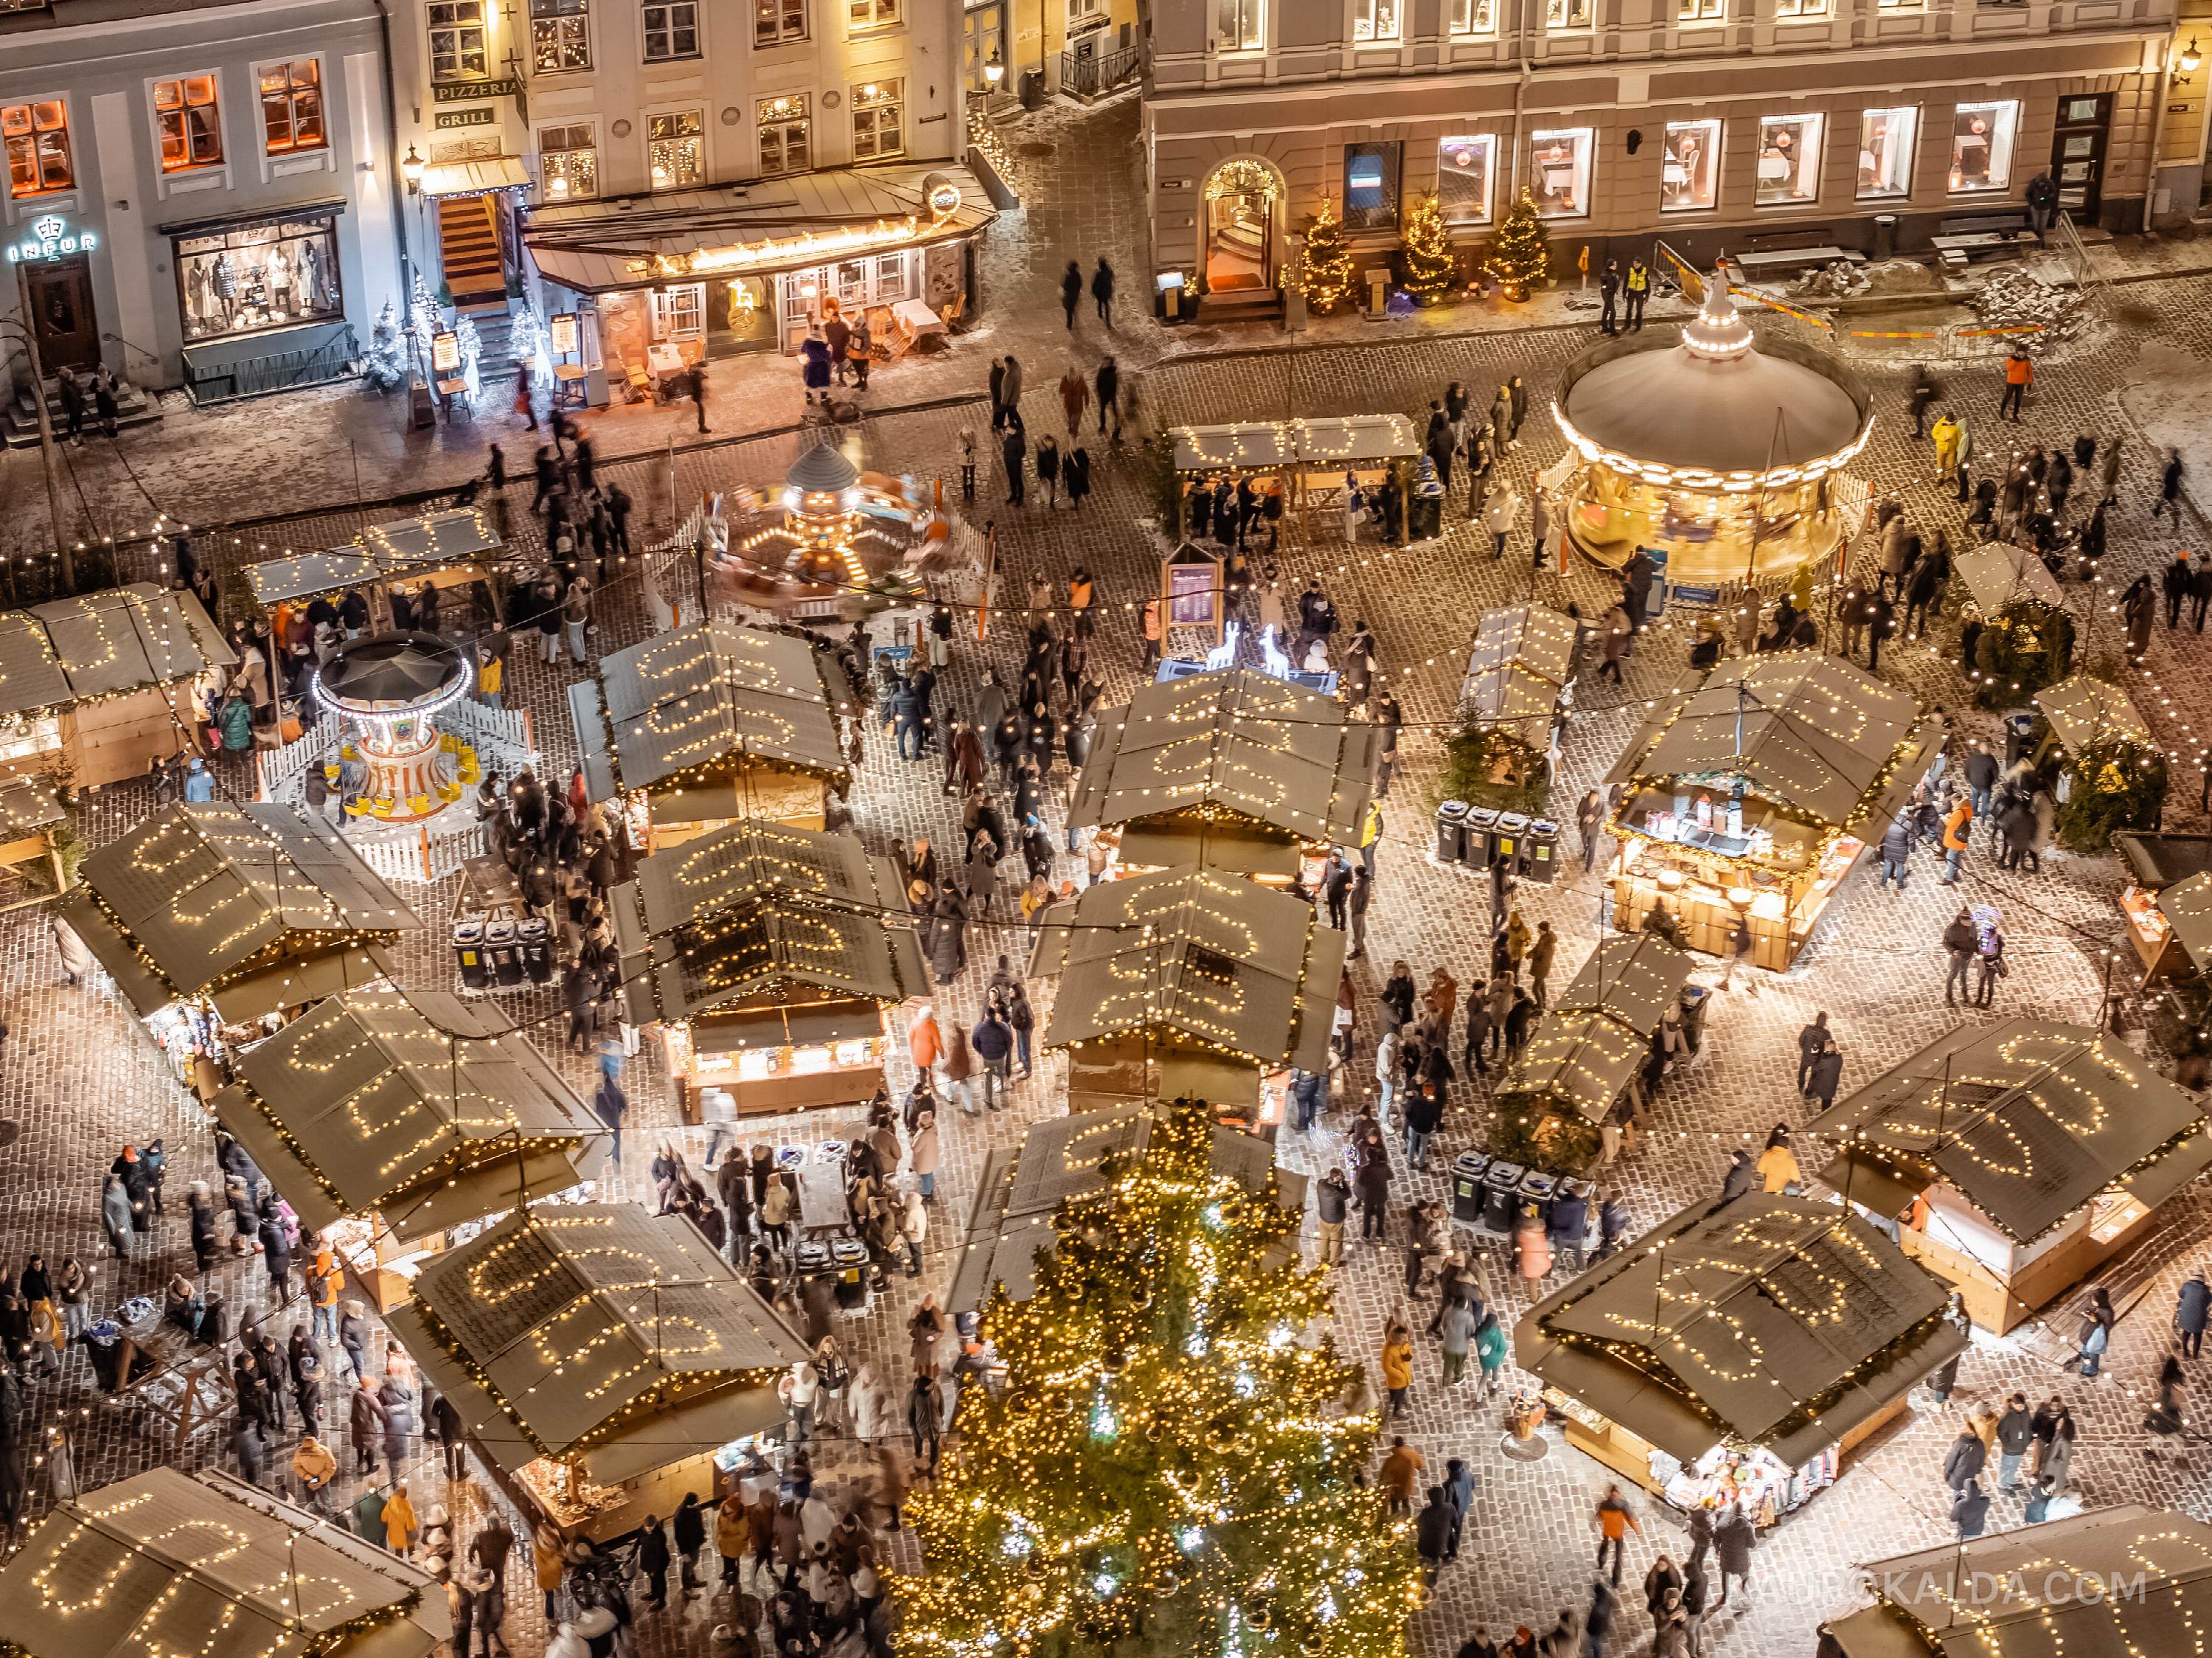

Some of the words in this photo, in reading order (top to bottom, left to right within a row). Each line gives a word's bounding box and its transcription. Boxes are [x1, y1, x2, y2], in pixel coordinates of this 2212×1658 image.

[438, 82, 516, 100] PIZZERIA
[438, 112, 490, 127] GRILL
[10, 237, 96, 260] INFUR
